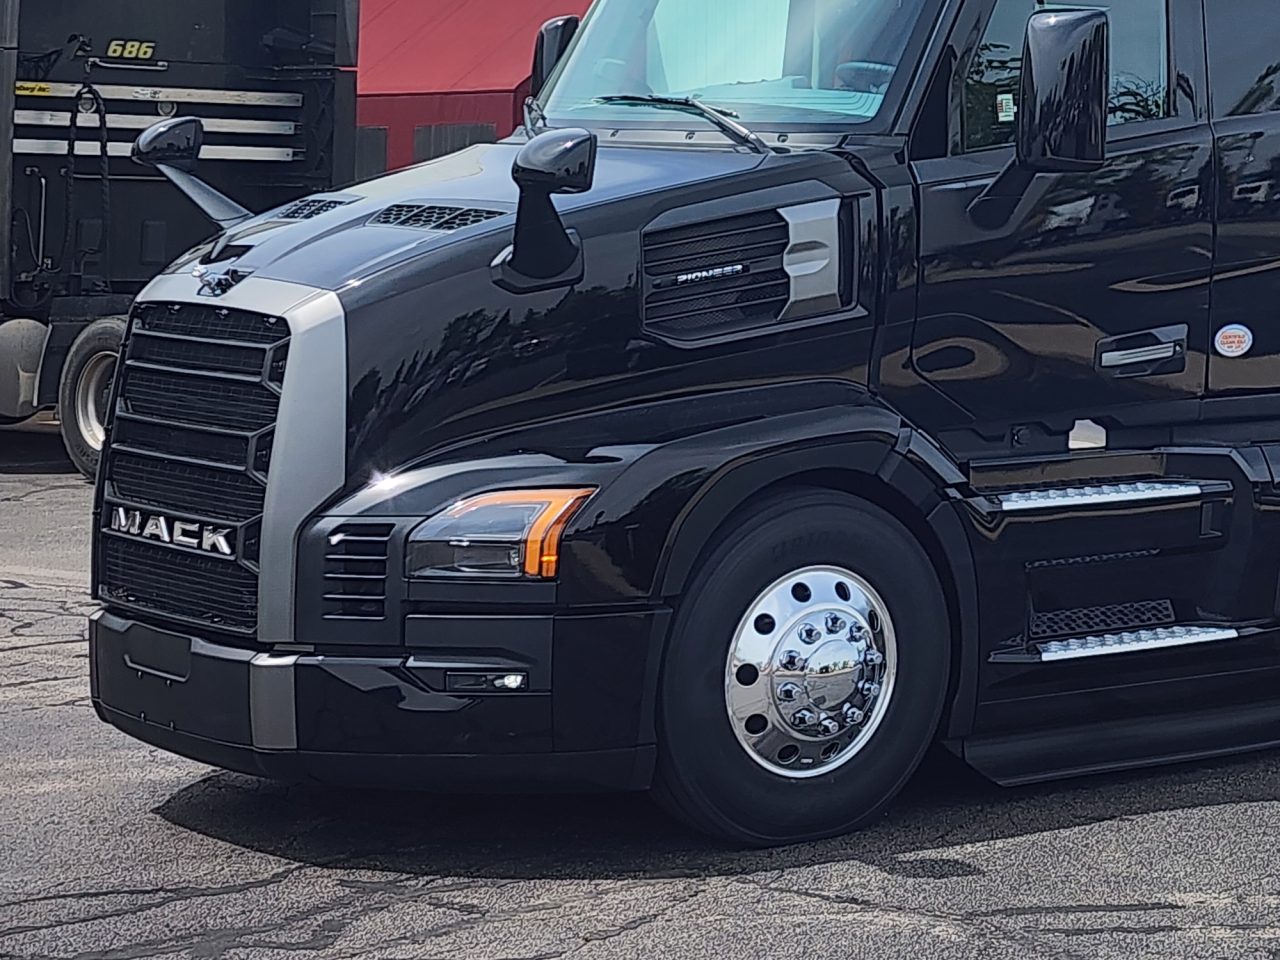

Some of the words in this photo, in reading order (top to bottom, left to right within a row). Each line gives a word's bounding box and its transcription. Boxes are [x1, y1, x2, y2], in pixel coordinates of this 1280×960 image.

[106, 40, 156, 59] 686
[677, 265, 743, 285] PIONEER
[110, 506, 233, 555] MACK
